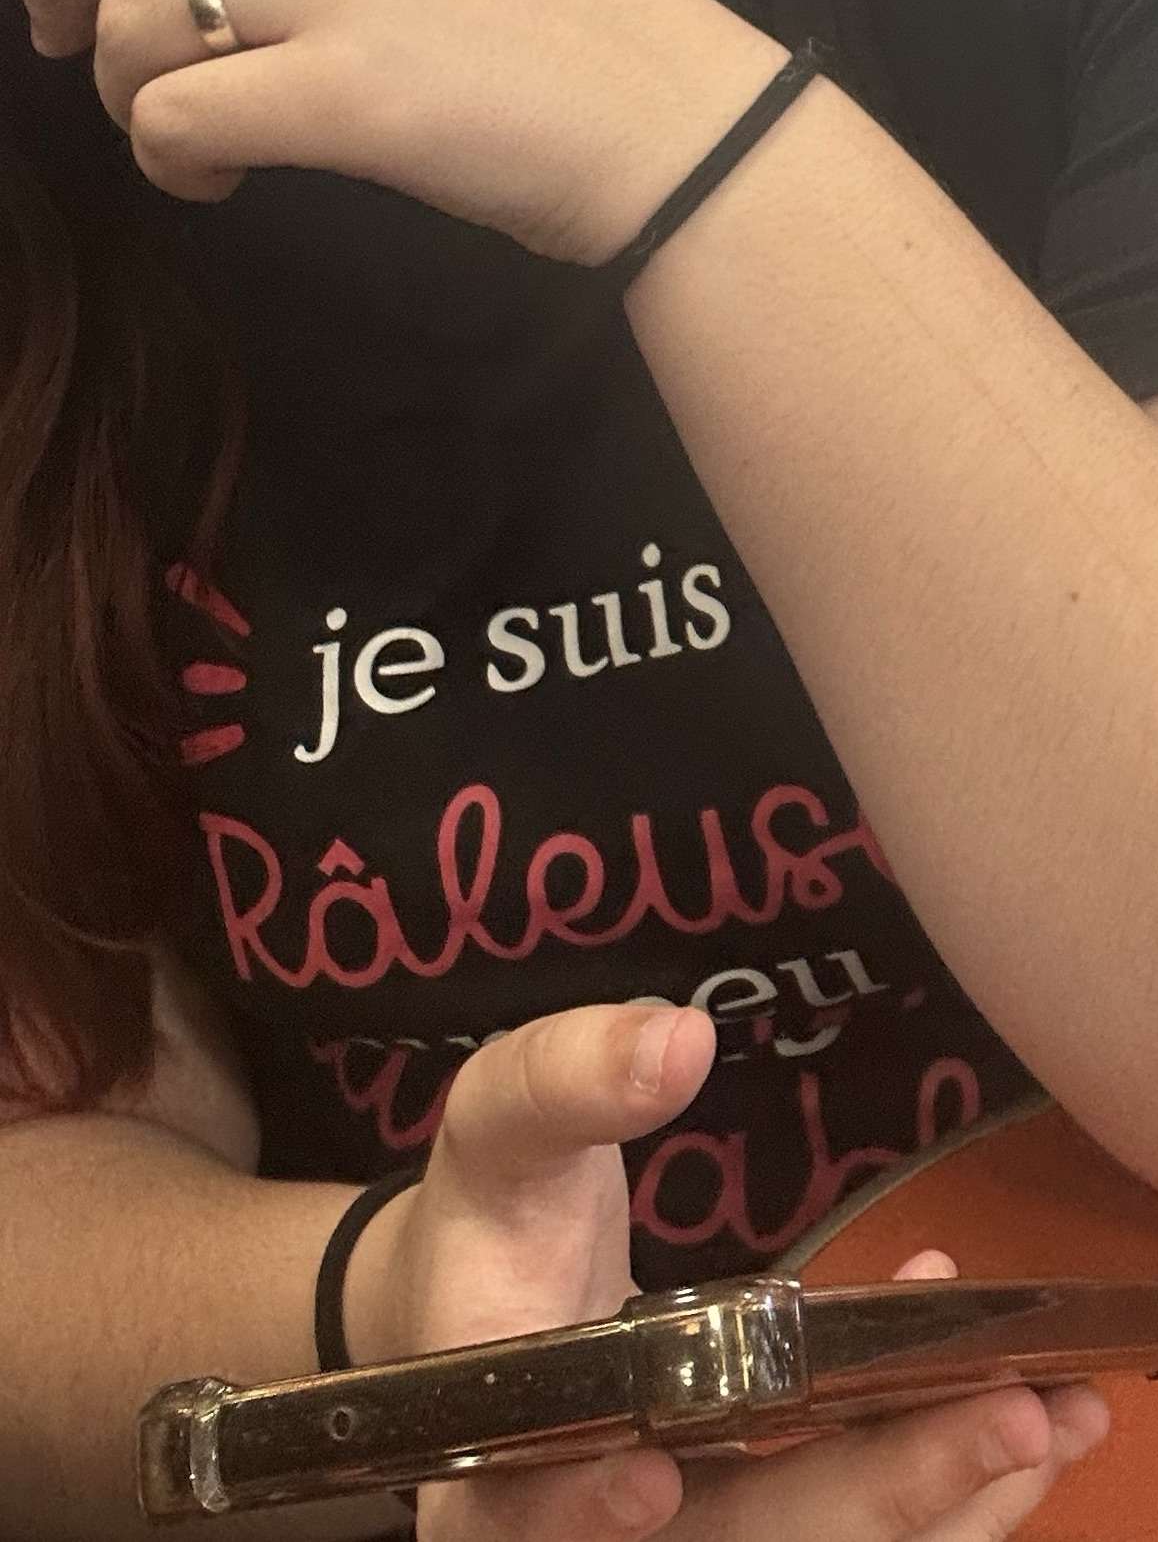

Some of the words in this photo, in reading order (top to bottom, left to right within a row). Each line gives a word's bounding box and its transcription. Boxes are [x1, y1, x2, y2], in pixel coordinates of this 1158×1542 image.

[294, 607, 446, 763] je
[487, 542, 731, 692] suis
[628, 948, 890, 1059] eu
